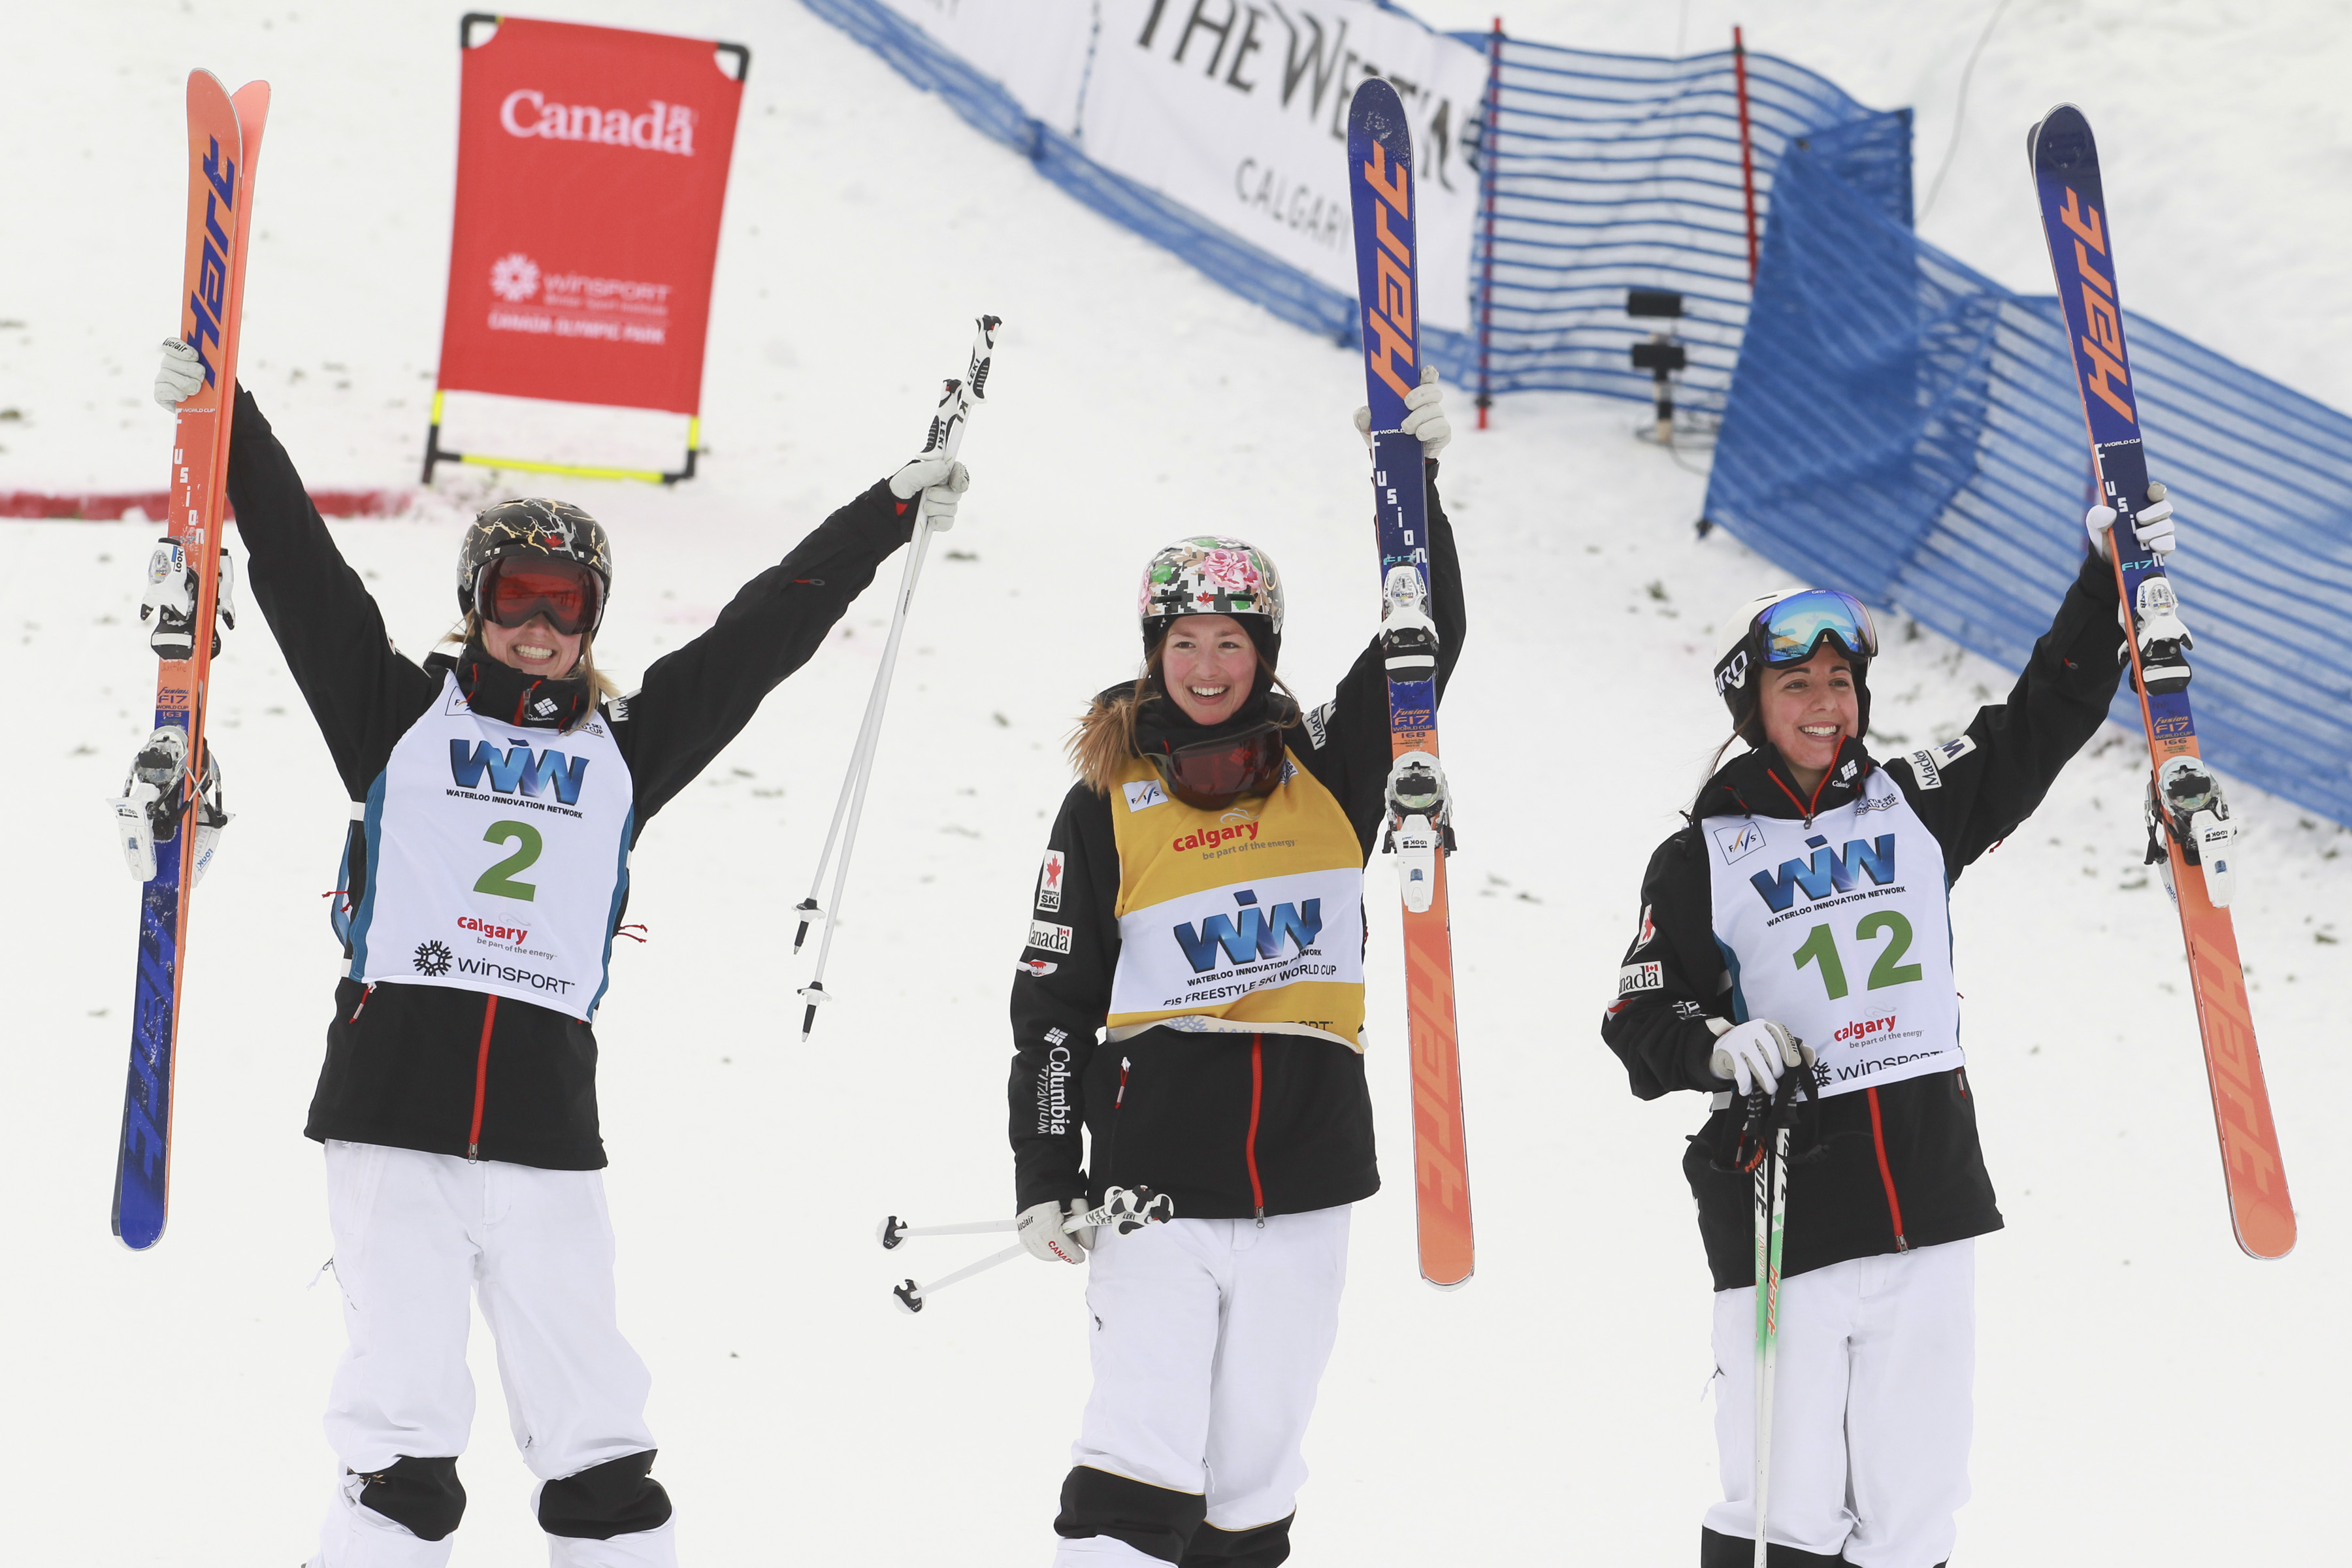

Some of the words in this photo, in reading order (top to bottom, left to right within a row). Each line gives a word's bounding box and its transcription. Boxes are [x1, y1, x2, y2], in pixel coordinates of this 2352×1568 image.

[500, 89, 695, 156] Canada
[1235, 157, 1354, 246] CALGAR
[1364, 139, 1414, 400] Hart
[2059, 186, 2134, 425] Hart
[968, 358, 981, 386] LEKI
[938, 420, 947, 450] LEKI
[175, 549, 184, 573] LOOK
[2121, 560, 2153, 572] F17
[1716, 650, 1748, 694] IRO
[158, 695, 188, 704] F17
[589, 727, 603, 735] CUP
[1394, 715, 1429, 726] F17
[2155, 721, 2189, 734] F17
[2164, 738, 2187, 746] 166
[446, 789, 490, 802] WATERLOO
[492, 796, 546, 811] INNOVATION
[546, 805, 583, 819] NETWORK
[1882, 797, 1897, 808] CUP
[1172, 821, 1259, 852] calgary
[1202, 850, 1215, 860] be
[1217, 845, 1237, 860] part
[1239, 843, 1249, 852] of
[1250, 841, 1266, 851] the
[1267, 838, 1296, 848] energy
[473, 819, 544, 902] 2
[1041, 894, 1059, 905] SKI
[1766, 906, 1812, 928] WATERLOO
[1813, 892, 1867, 911] INNOVATION
[1868, 885, 1906, 898] NETWORK
[457, 916, 528, 945] calgary
[1028, 922, 1069, 952] Canada
[477, 937, 487, 945] be
[488, 939, 504, 950] part
[514, 946, 527, 955] the
[529, 949, 555, 961] energy
[1792, 909, 1922, 1000] 12
[1184, 981, 1256, 1004] FREESTYLE
[1258, 973, 1277, 987] SKI
[1279, 964, 1320, 982] WORLD
[1320, 965, 1337, 975] CUP
[1186, 970, 1233, 987] WATERLOO
[1235, 960, 1288, 979] INNOVATION
[1620, 966, 1661, 993] nada
[1833, 1015, 1896, 1042] calgary
[1861, 1037, 1878, 1047] part
[1879, 1034, 1887, 1043] of
[1409, 939, 1463, 1211] Hart
[2195, 932, 2275, 1196] Hart
[1037, 1065, 1049, 1134] TITANIUM
[1049, 1047, 1071, 1135] Columbia
[1767, 1263, 1779, 1337] Hart
